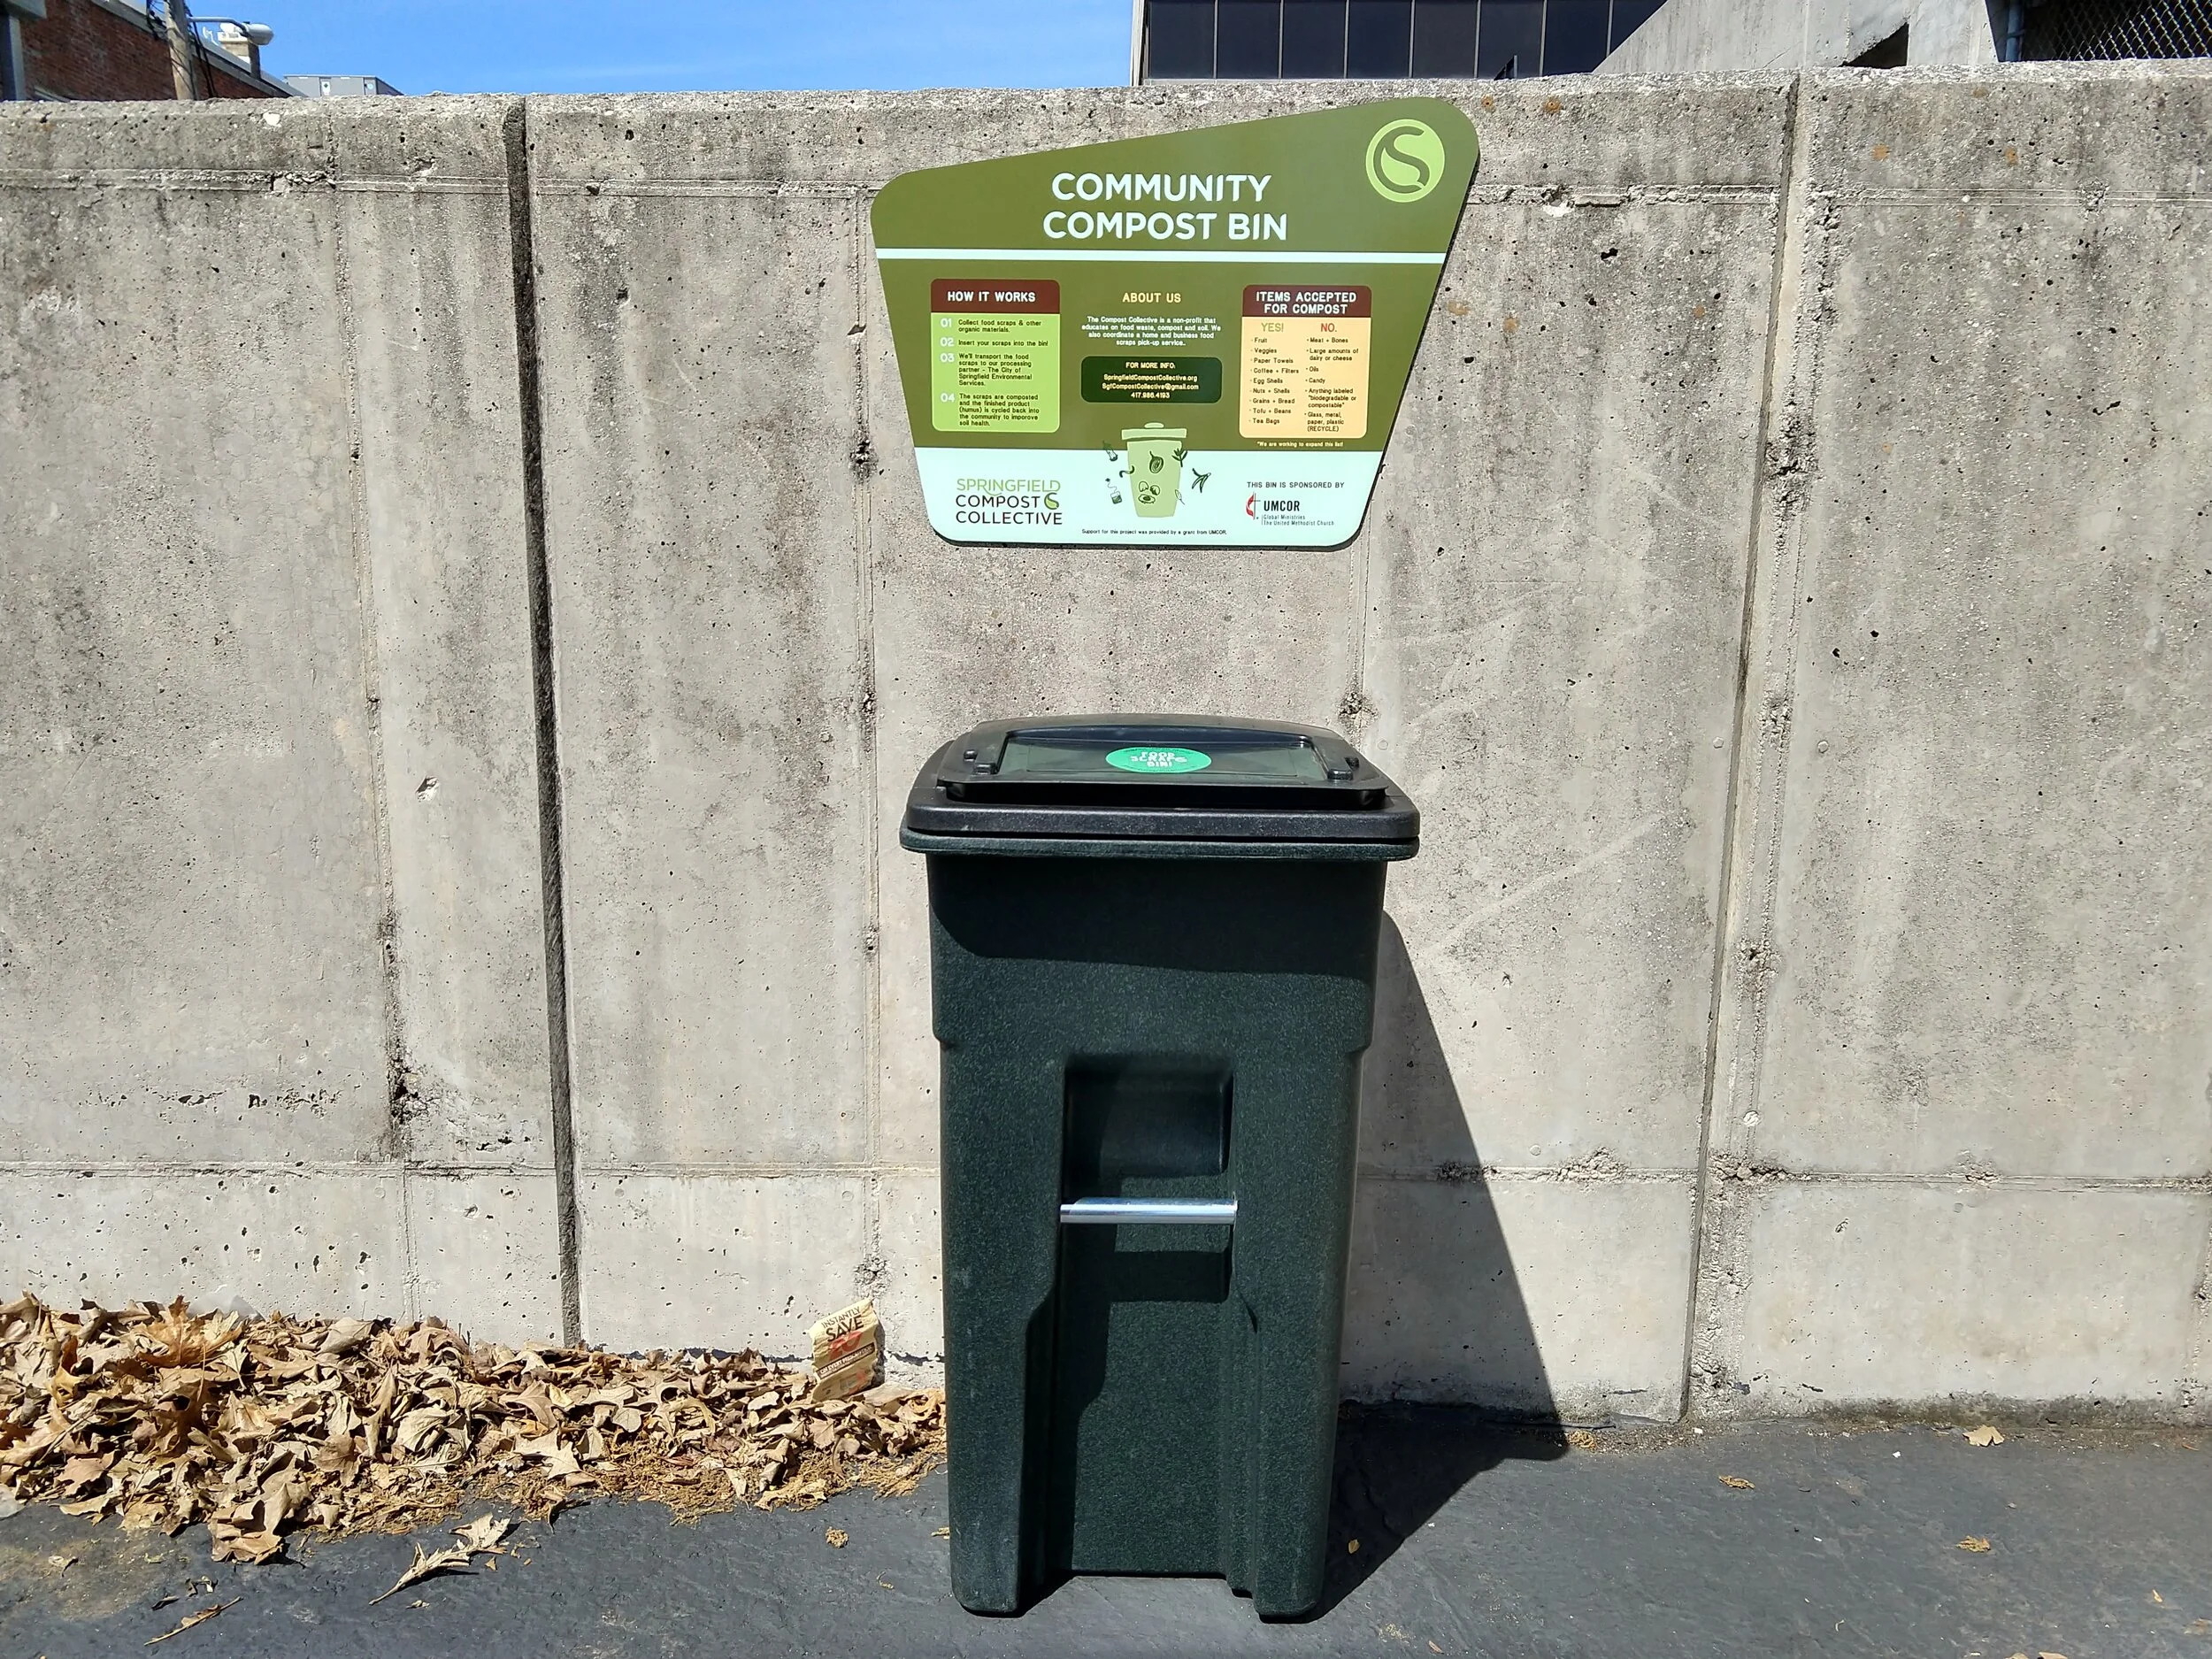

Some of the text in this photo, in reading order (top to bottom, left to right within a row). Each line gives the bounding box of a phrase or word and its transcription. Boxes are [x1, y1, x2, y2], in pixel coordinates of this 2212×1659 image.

[1052, 173, 1271, 202] COMMUNITY
[1043, 211, 1286, 241] COMPOST BIN
[947, 291, 1036, 303] HOW IT WORKS
[1122, 292, 1181, 303] ABOUT US
[1256, 291, 1356, 303] ITEMS ACCEPTED
[1264, 303, 1348, 314] FOR COMPOST
[941, 318, 952, 327] 01
[1261, 322, 1284, 332] YES!
[1320, 323, 1337, 333] NO.
[940, 337, 954, 347] 02
[940, 353, 955, 363] 03
[940, 393, 955, 403] 04
[956, 479, 1061, 495] SPRINGFIELD
[956, 495, 1041, 508] COMPOST
[1263, 500, 1301, 511] UMCOR
[956, 511, 1063, 525] COLLECTIVE
[821, 1306, 861, 1328] INSTANTLY
[826, 1315, 864, 1342] SAVE
